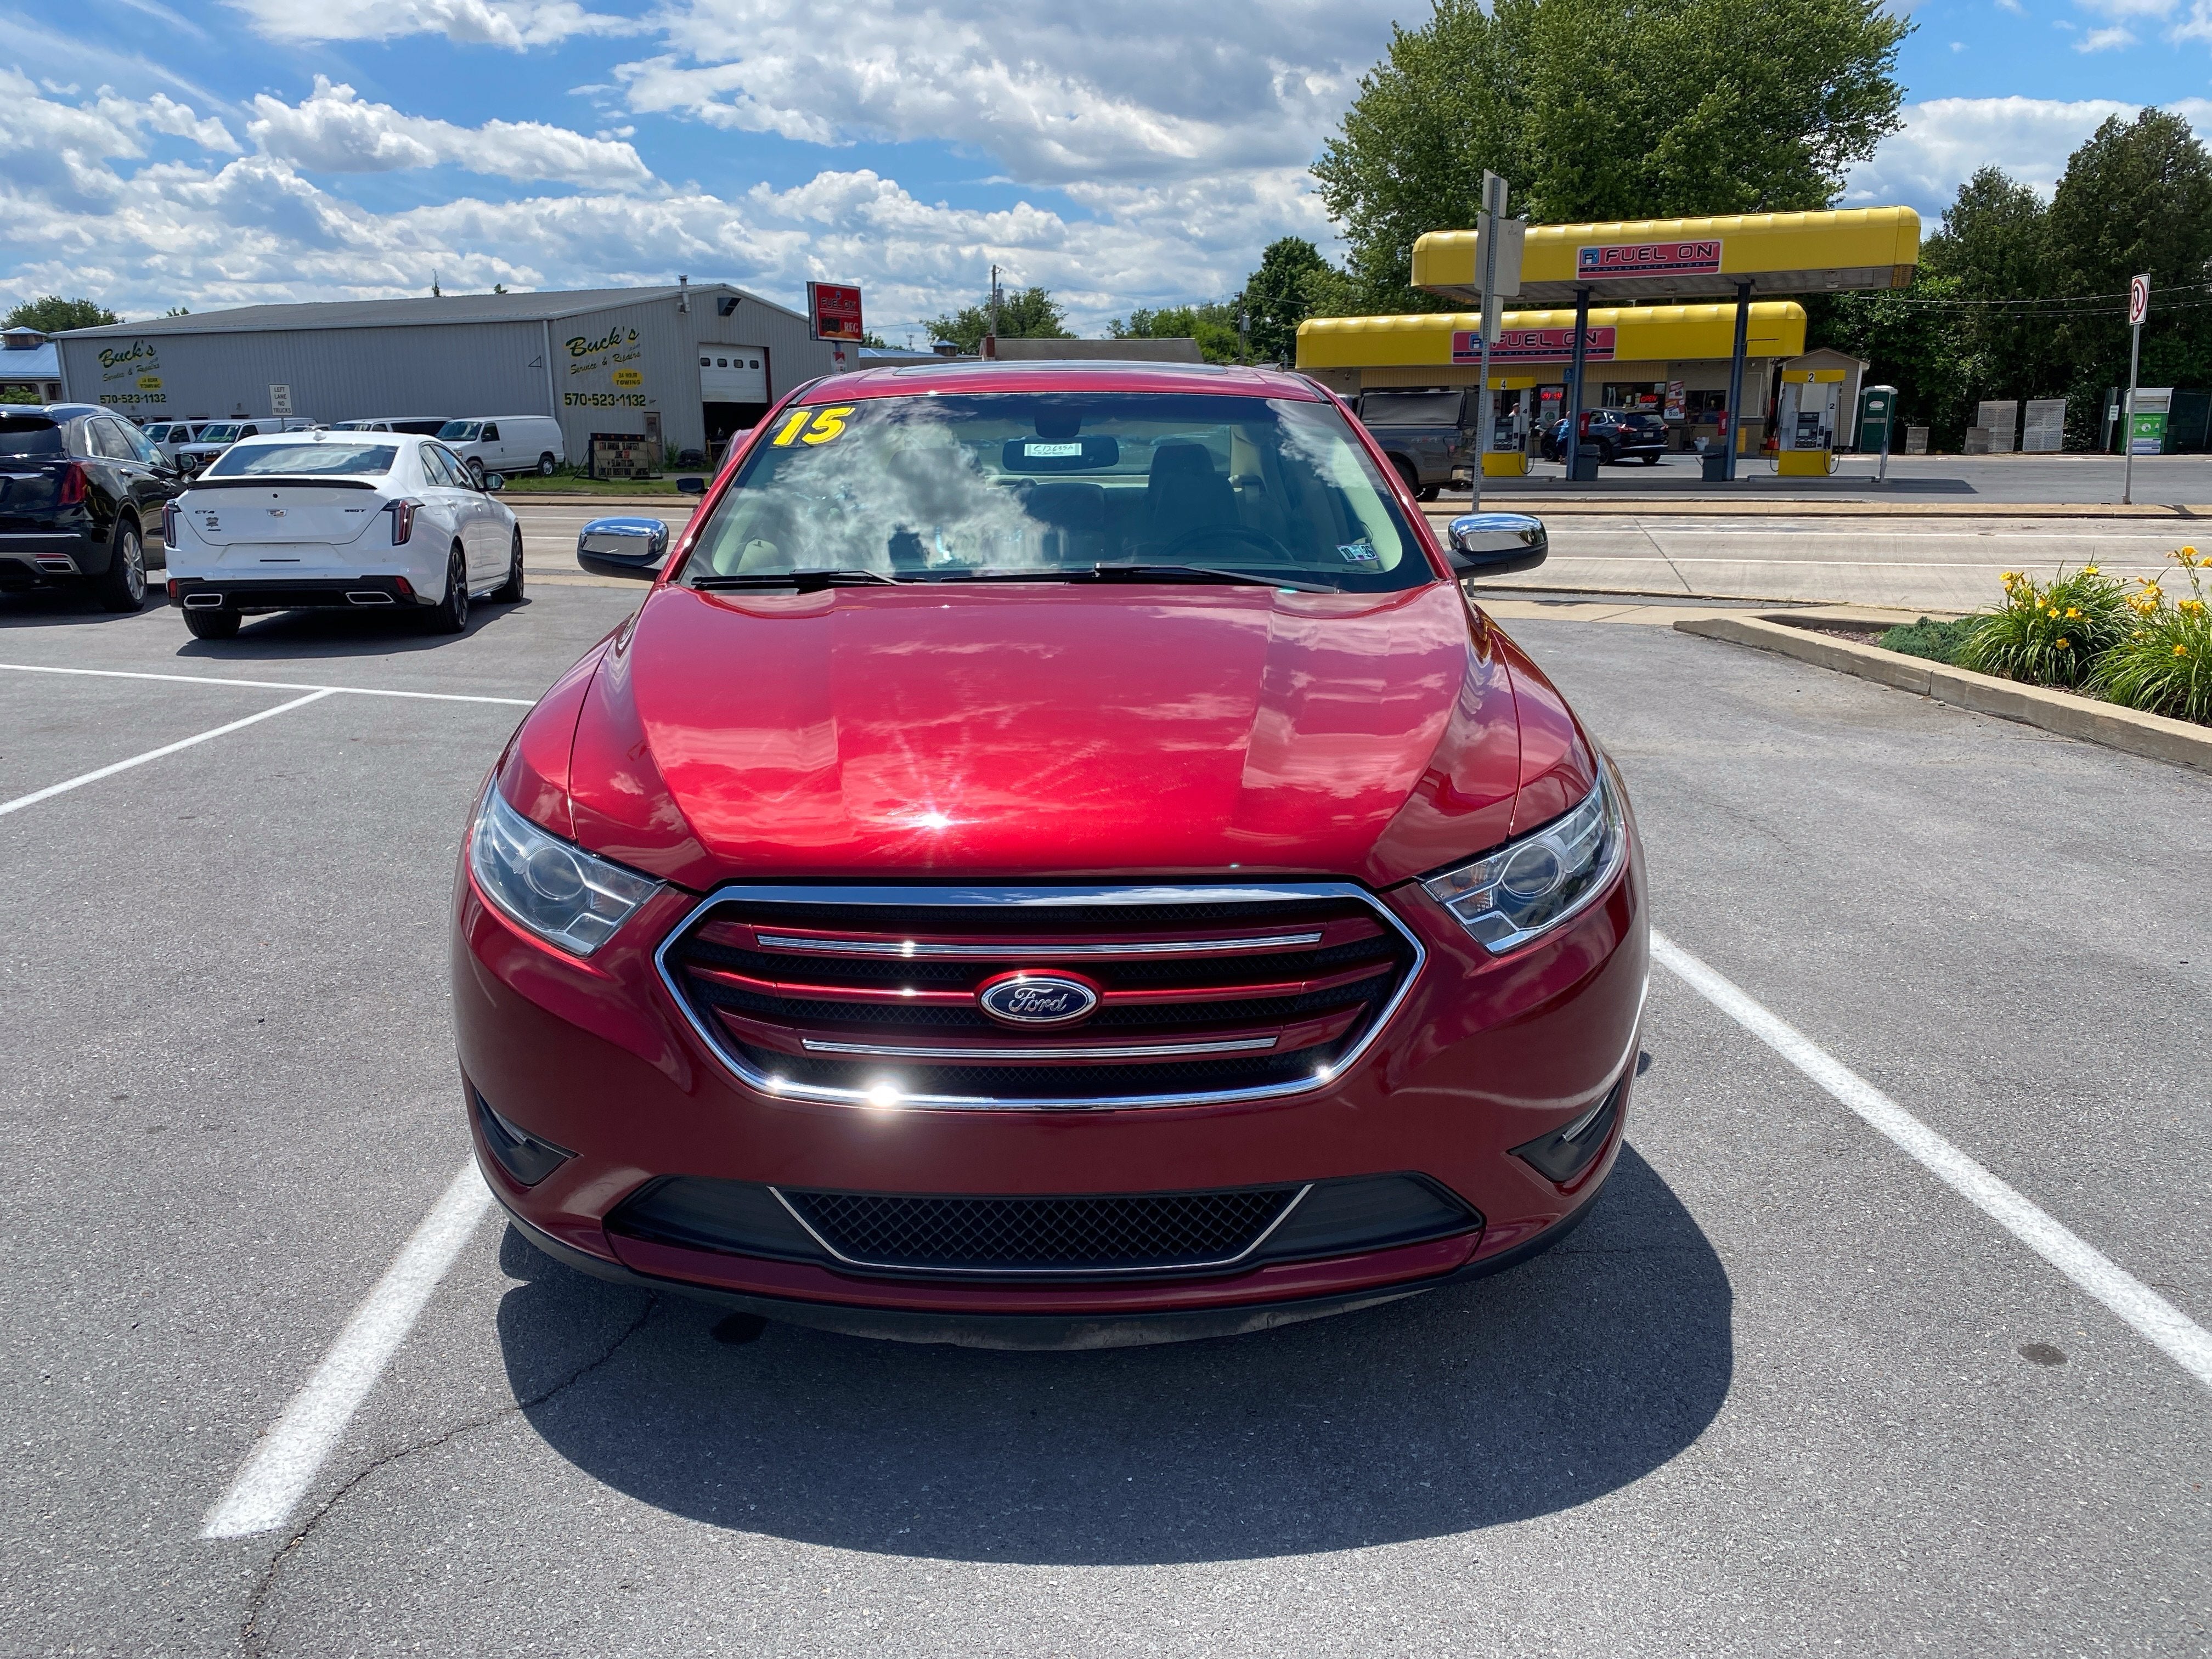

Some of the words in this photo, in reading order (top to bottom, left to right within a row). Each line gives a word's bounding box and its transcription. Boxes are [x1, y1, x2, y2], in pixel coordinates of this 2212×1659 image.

[1605, 246, 1667, 263] FUEL
[1678, 243, 1713, 260] ON
[821, 297, 843, 309] FUEL
[843, 300, 856, 311] ON
[844, 322, 859, 333] REG
[566, 326, 640, 357] Buck's
[98, 339, 157, 369] Buck's
[571, 363, 597, 375] Service
[602, 357, 608, 366] &
[612, 352, 641, 363] Repairs
[1501, 380, 1506, 390] 4
[1808, 373, 1814, 383] 2
[99, 393, 167, 404] 570-523-1132
[565, 392, 646, 407] 570-523-1132
[773, 407, 856, 447] 15
[1008, 988, 1068, 1012] Ford
